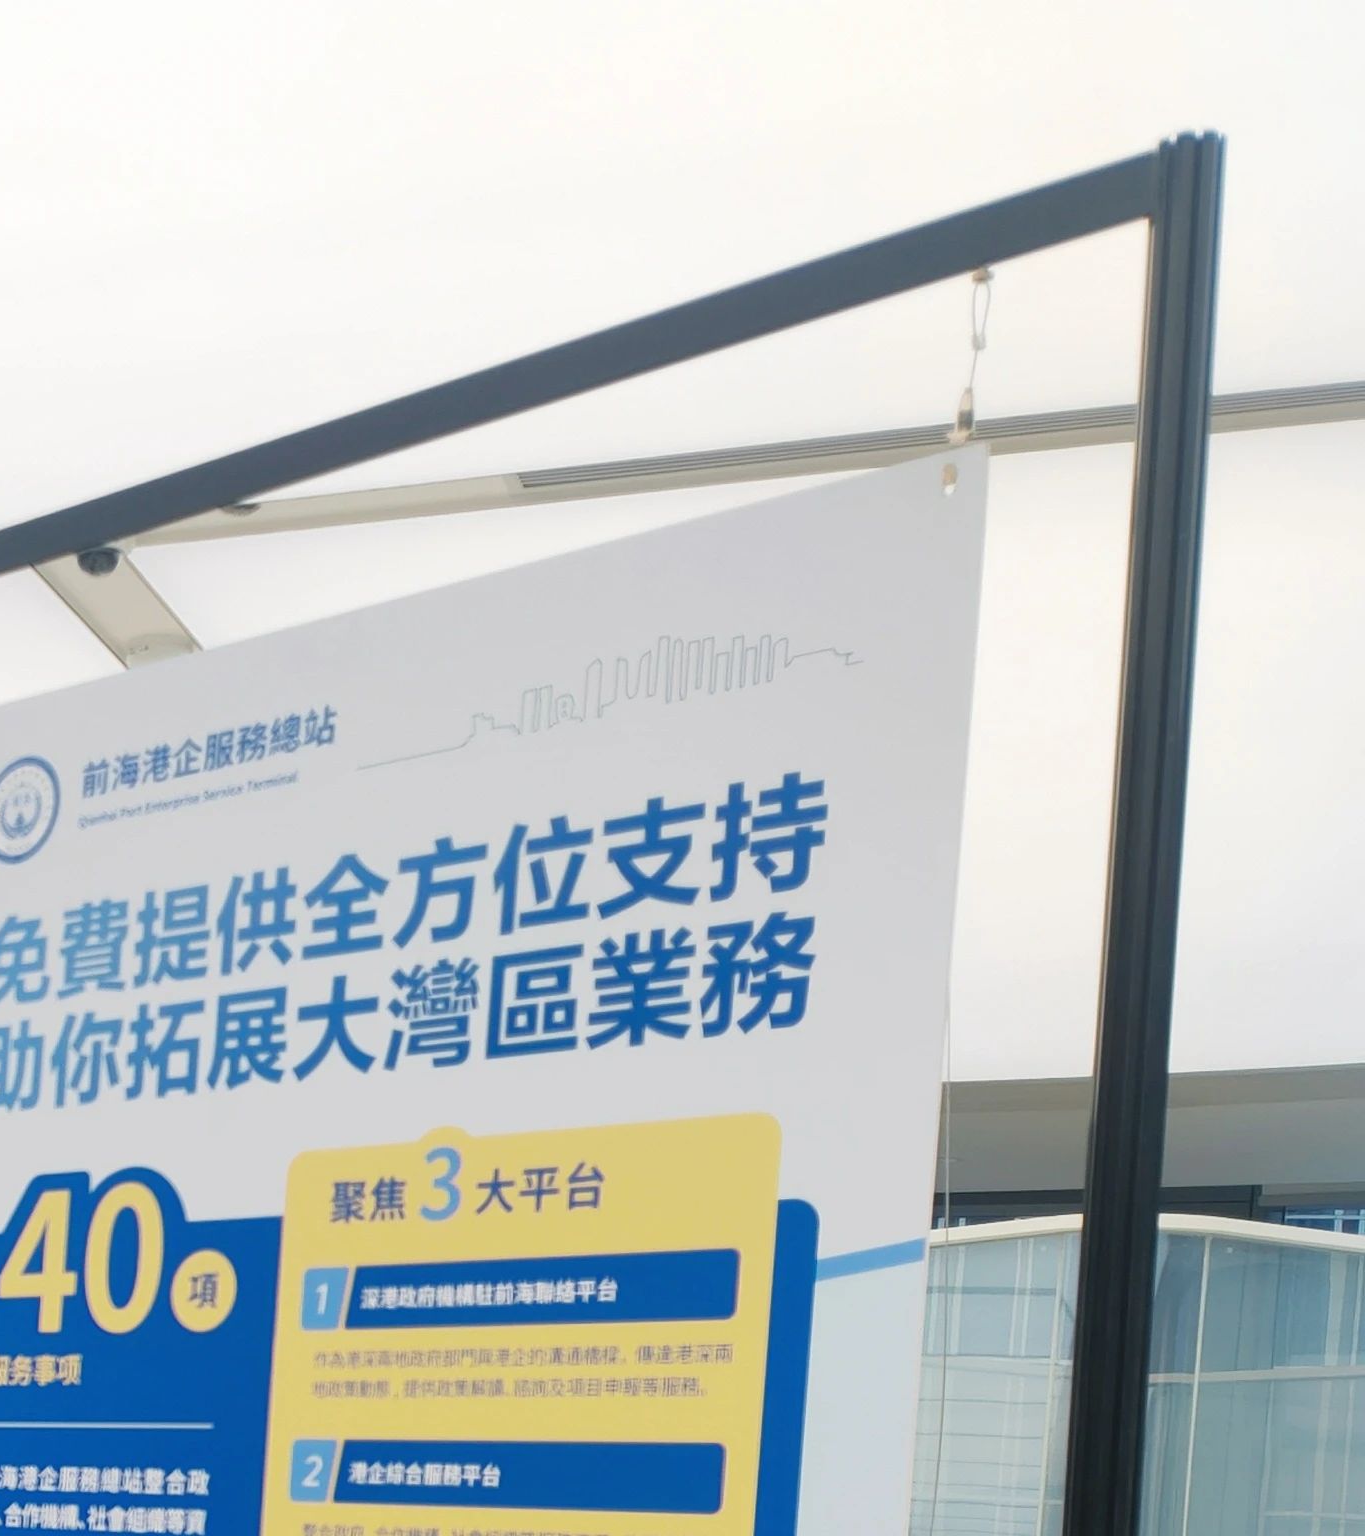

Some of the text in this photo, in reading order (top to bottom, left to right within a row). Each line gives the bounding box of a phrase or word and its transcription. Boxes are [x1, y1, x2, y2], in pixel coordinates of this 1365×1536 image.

[81, 705, 338, 799] 前海港企服務總站
[329, 1146, 606, 1225] 聚焦 3 大平台
[188, 1272, 220, 1309] 項
[313, 1283, 331, 1315] 1
[300, 1455, 324, 1488] 2
